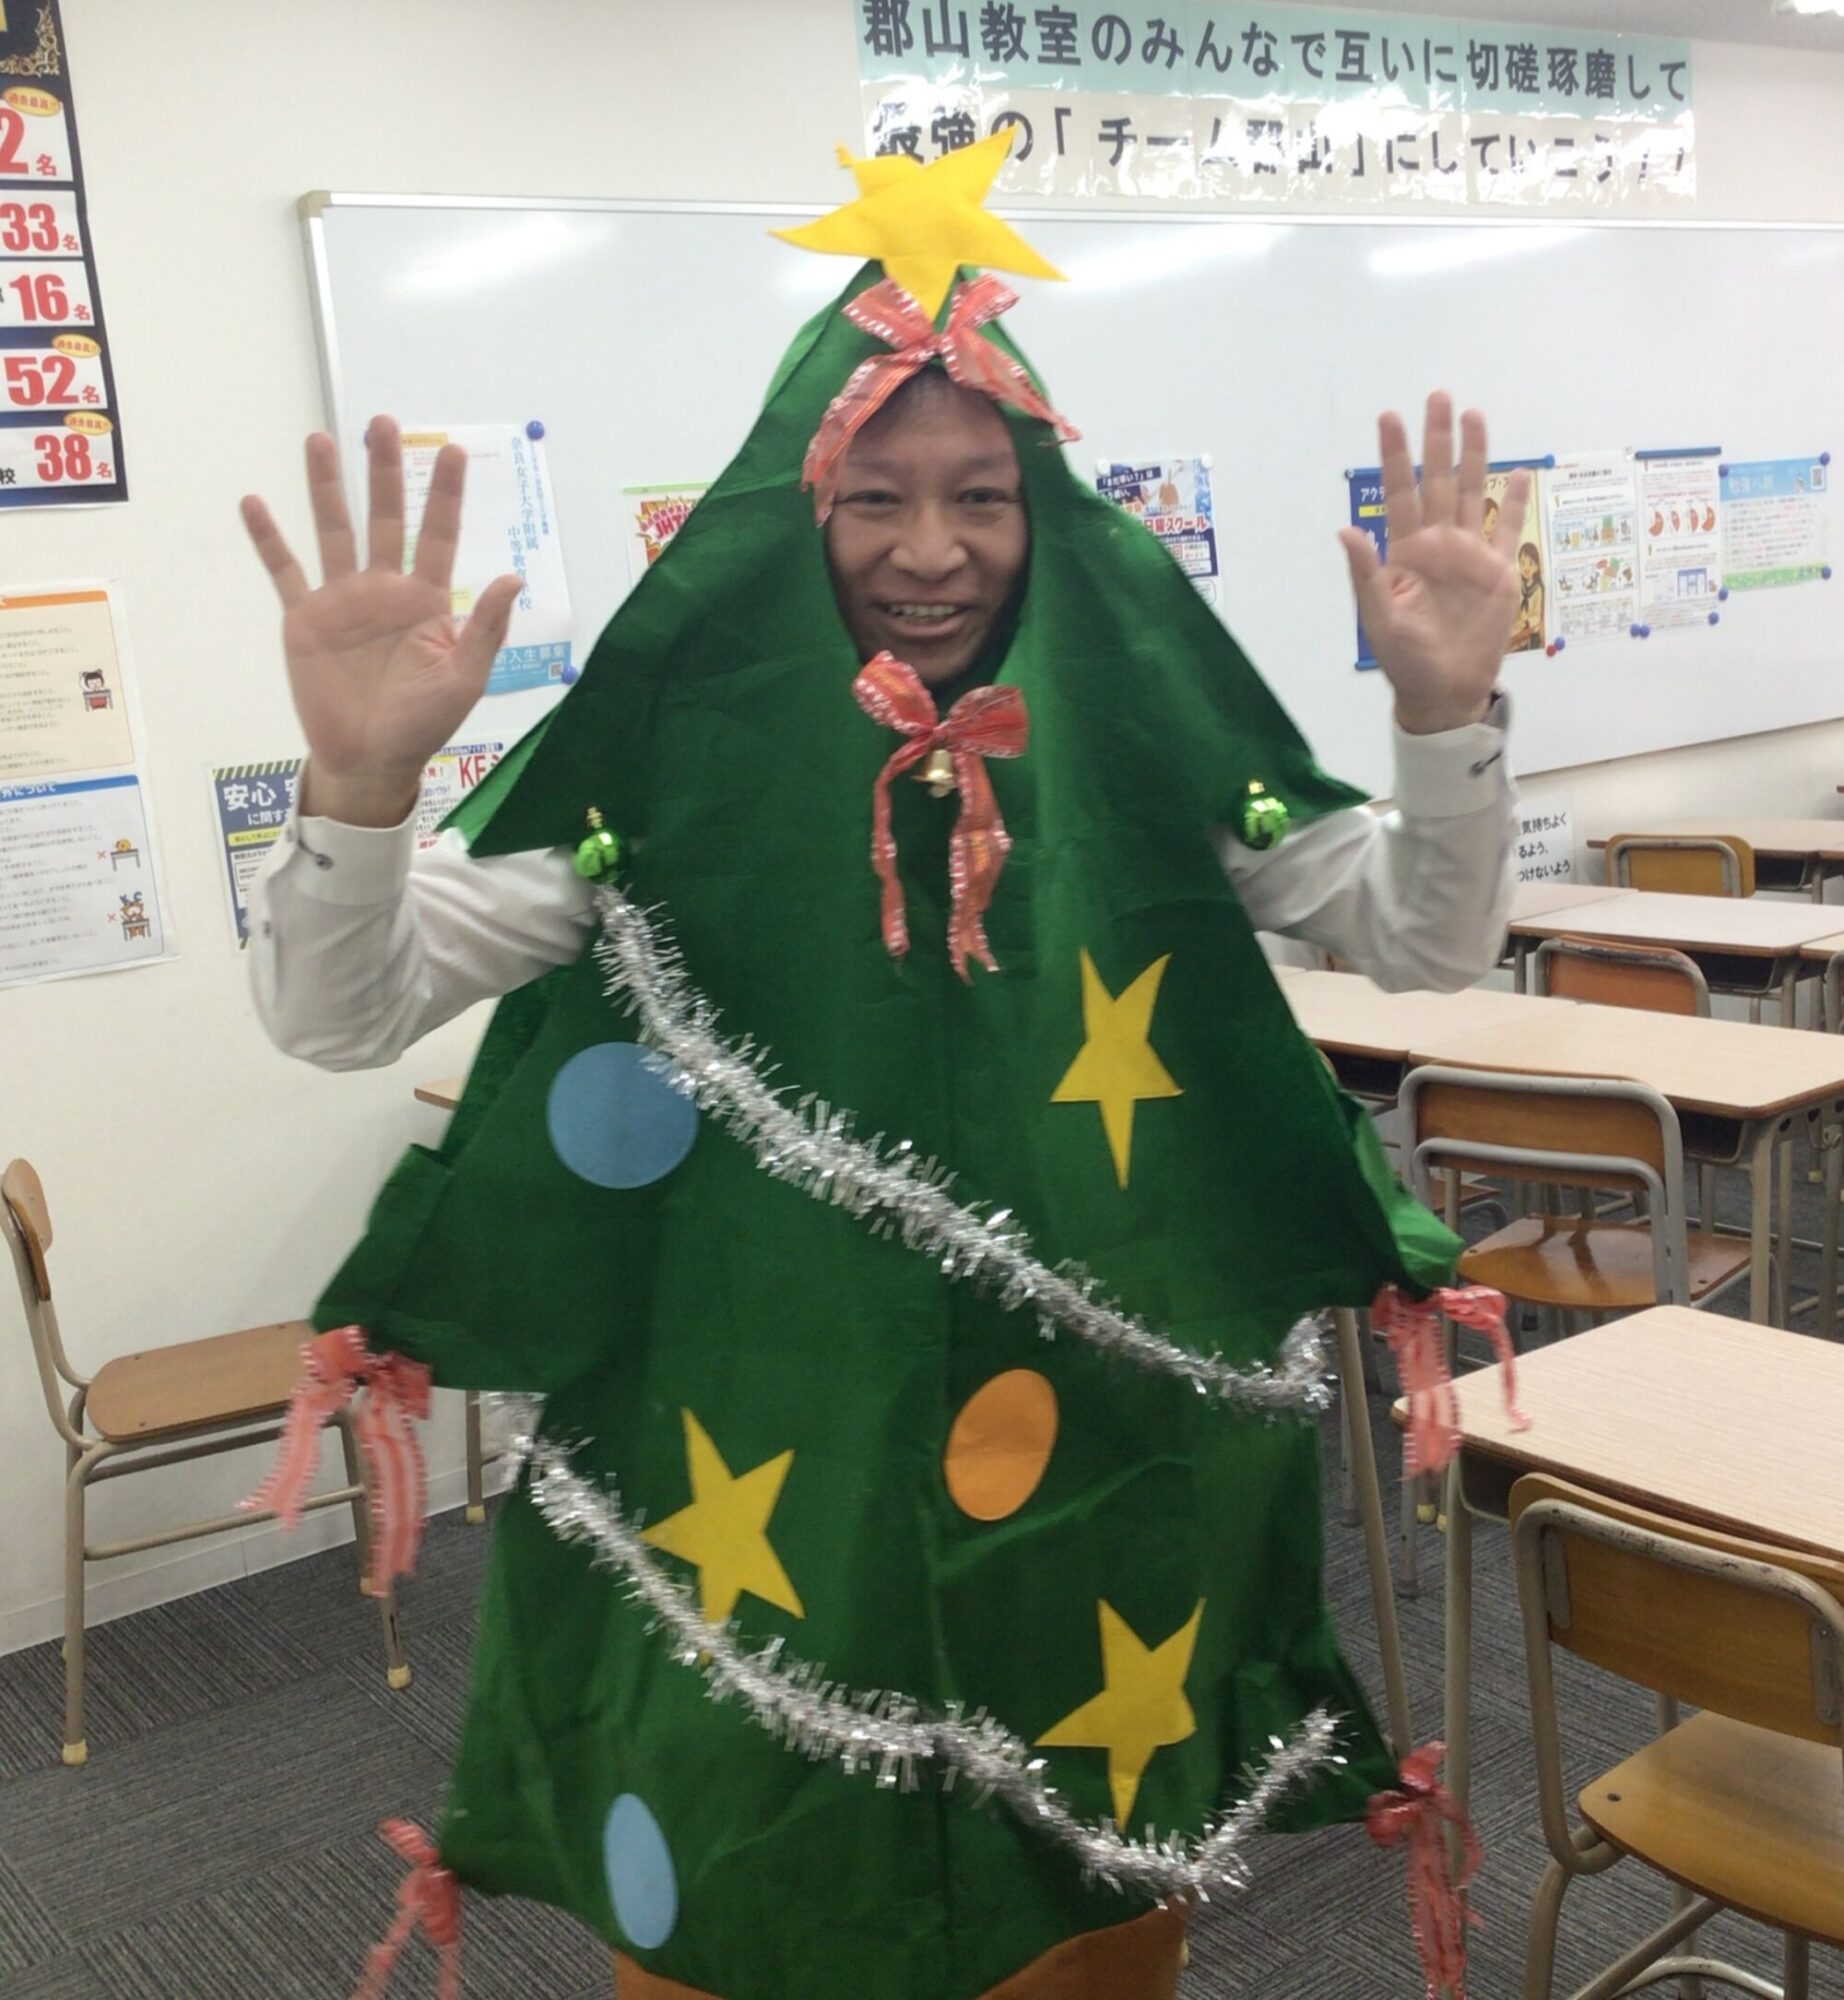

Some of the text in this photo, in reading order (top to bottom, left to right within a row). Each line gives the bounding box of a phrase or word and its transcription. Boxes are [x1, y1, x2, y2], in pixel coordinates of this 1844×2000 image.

[864, 0, 1687, 101] 郡山教室のみんなで互いに切磋琢磨して
[9, 273, 91, 322] 16名
[4, 355, 101, 406] 52名
[34, 433, 113, 483] 38名
[1144, 514, 1207, 534] 日曜スクール
[223, 781, 278, 812] 安心
[1521, 812, 1567, 835] 気持ちよく
